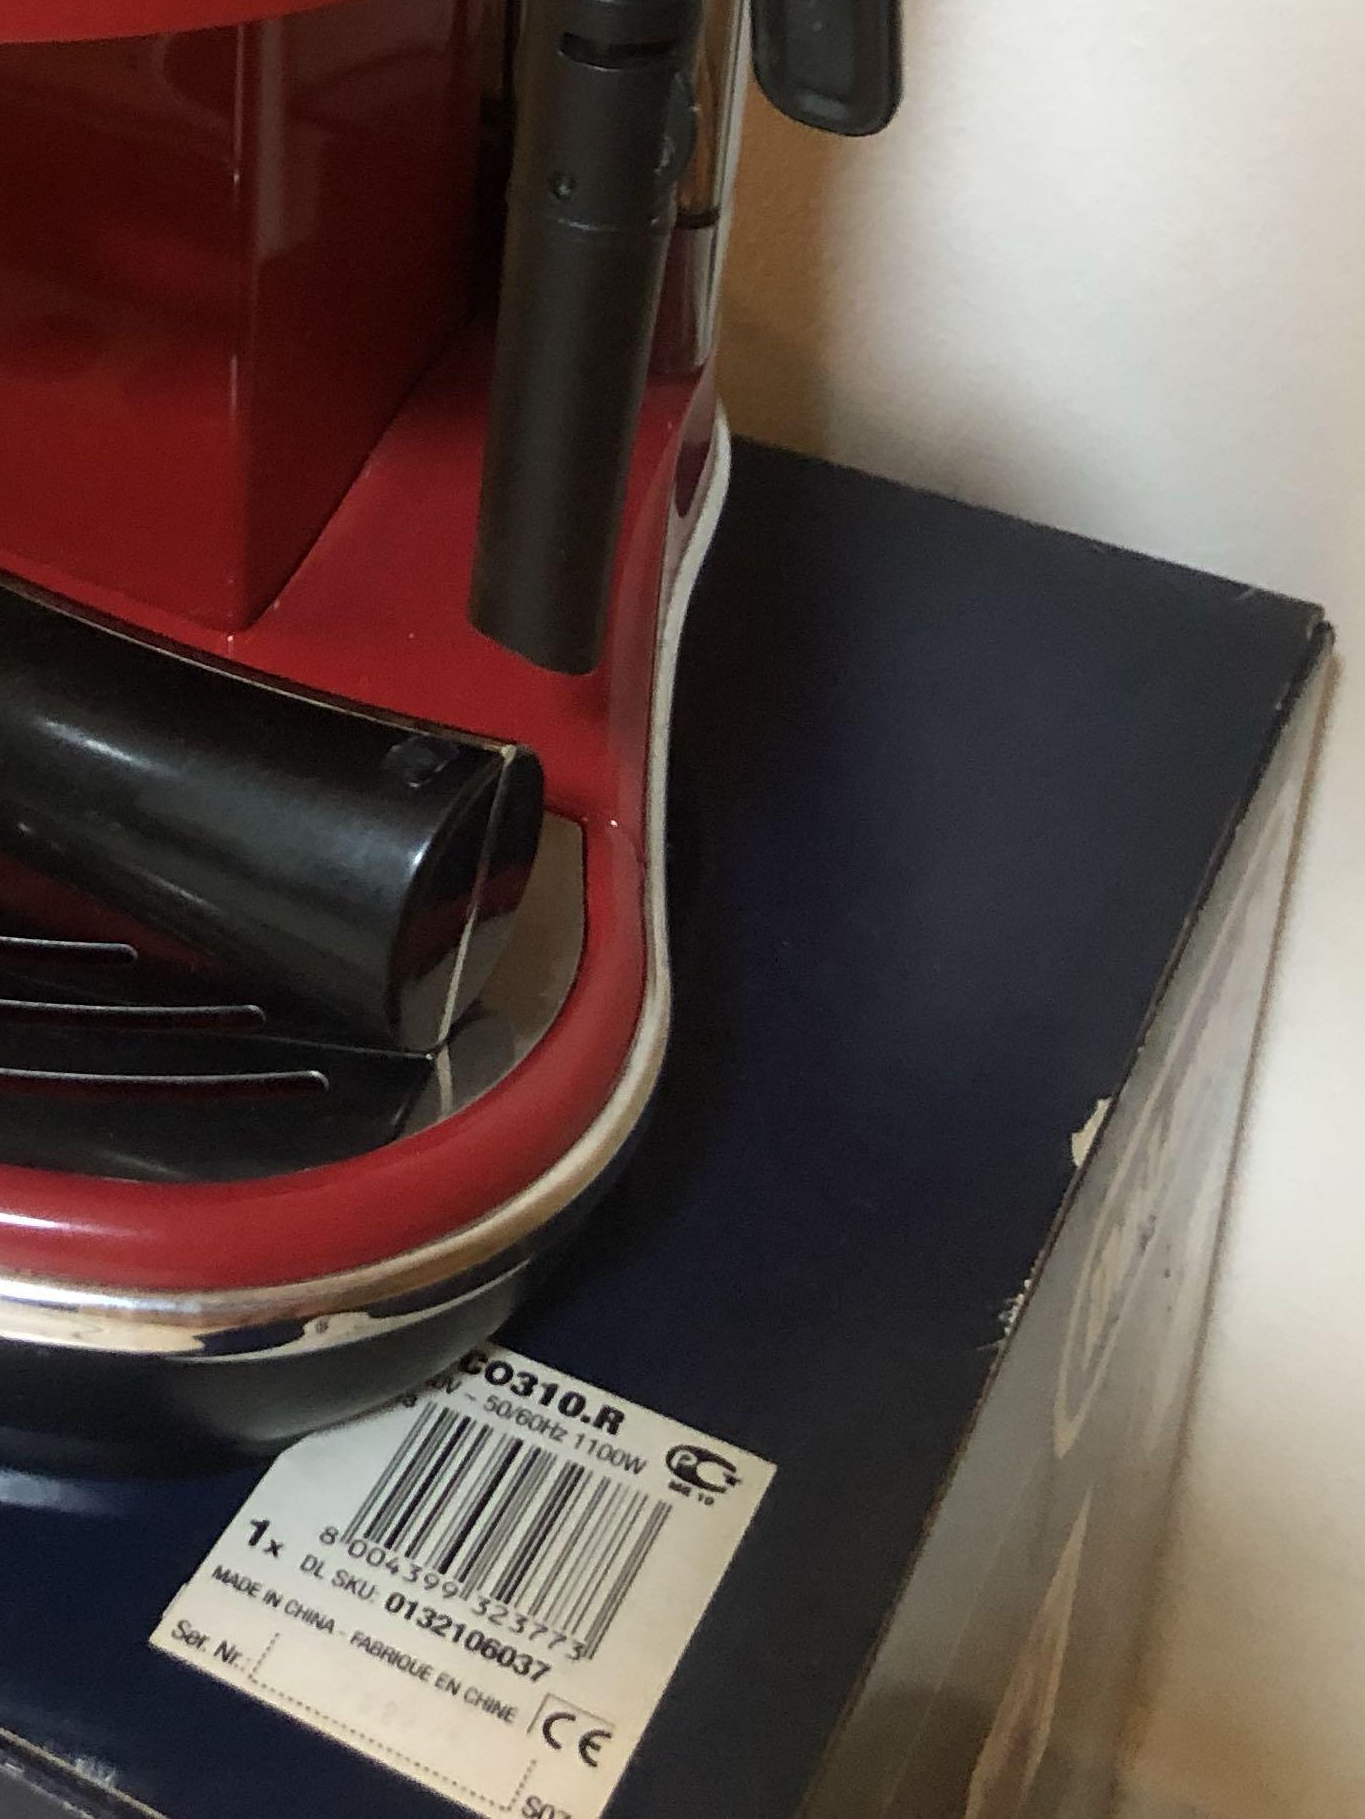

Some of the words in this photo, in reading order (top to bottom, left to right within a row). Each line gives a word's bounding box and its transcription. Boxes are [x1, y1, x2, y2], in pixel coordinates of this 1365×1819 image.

[483, 1394, 568, 1442] 50/60Hz
[573, 1432, 649, 1475] 1100W
[319, 1525, 339, 1546] 8
[170, 1618, 210, 1653] Ser.
[211, 1564, 263, 1598] MADE
[263, 1588, 284, 1609] IN
[284, 1598, 336, 1634] CHINA
[349, 1630, 435, 1683] FABRIQUE
[434, 1671, 462, 1697] EN
[463, 1685, 520, 1725] CHINE
[299, 1553, 326, 1580] DL
[385, 1591, 552, 1684] 0132106037
